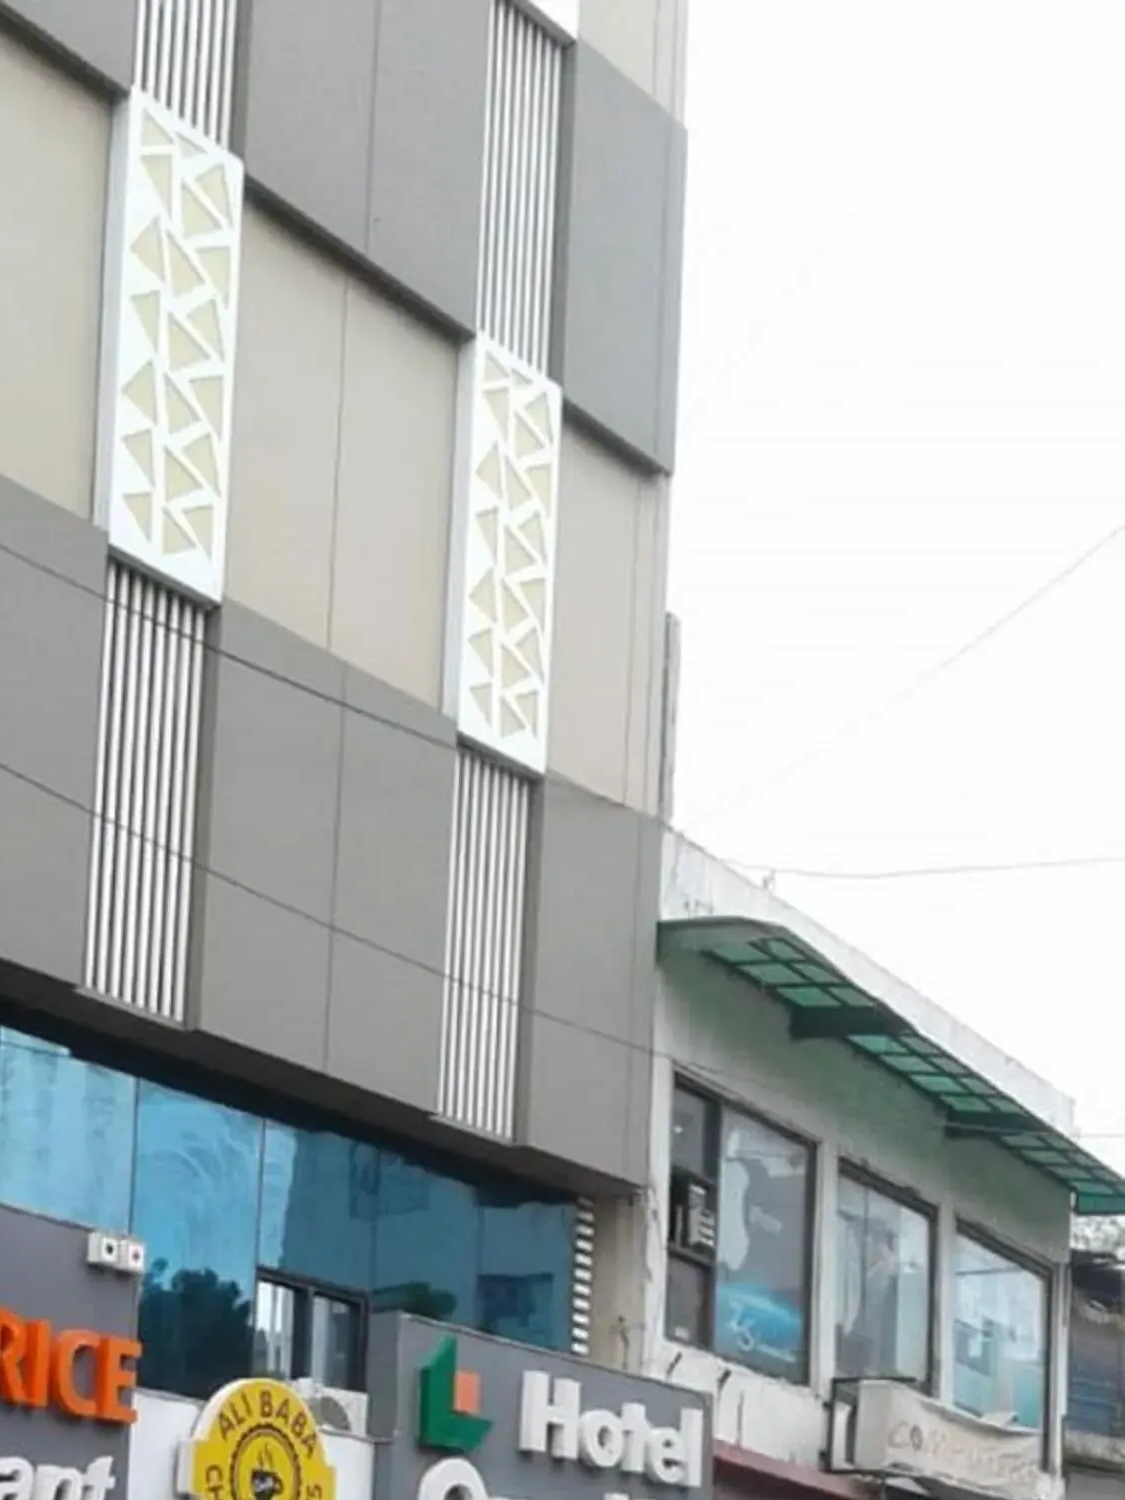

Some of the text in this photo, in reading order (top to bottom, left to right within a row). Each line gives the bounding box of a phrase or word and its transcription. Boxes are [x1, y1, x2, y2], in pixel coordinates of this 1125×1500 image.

[217, 1390, 318, 1459] ALI BABA
[517, 1368, 704, 1487] Hotel
